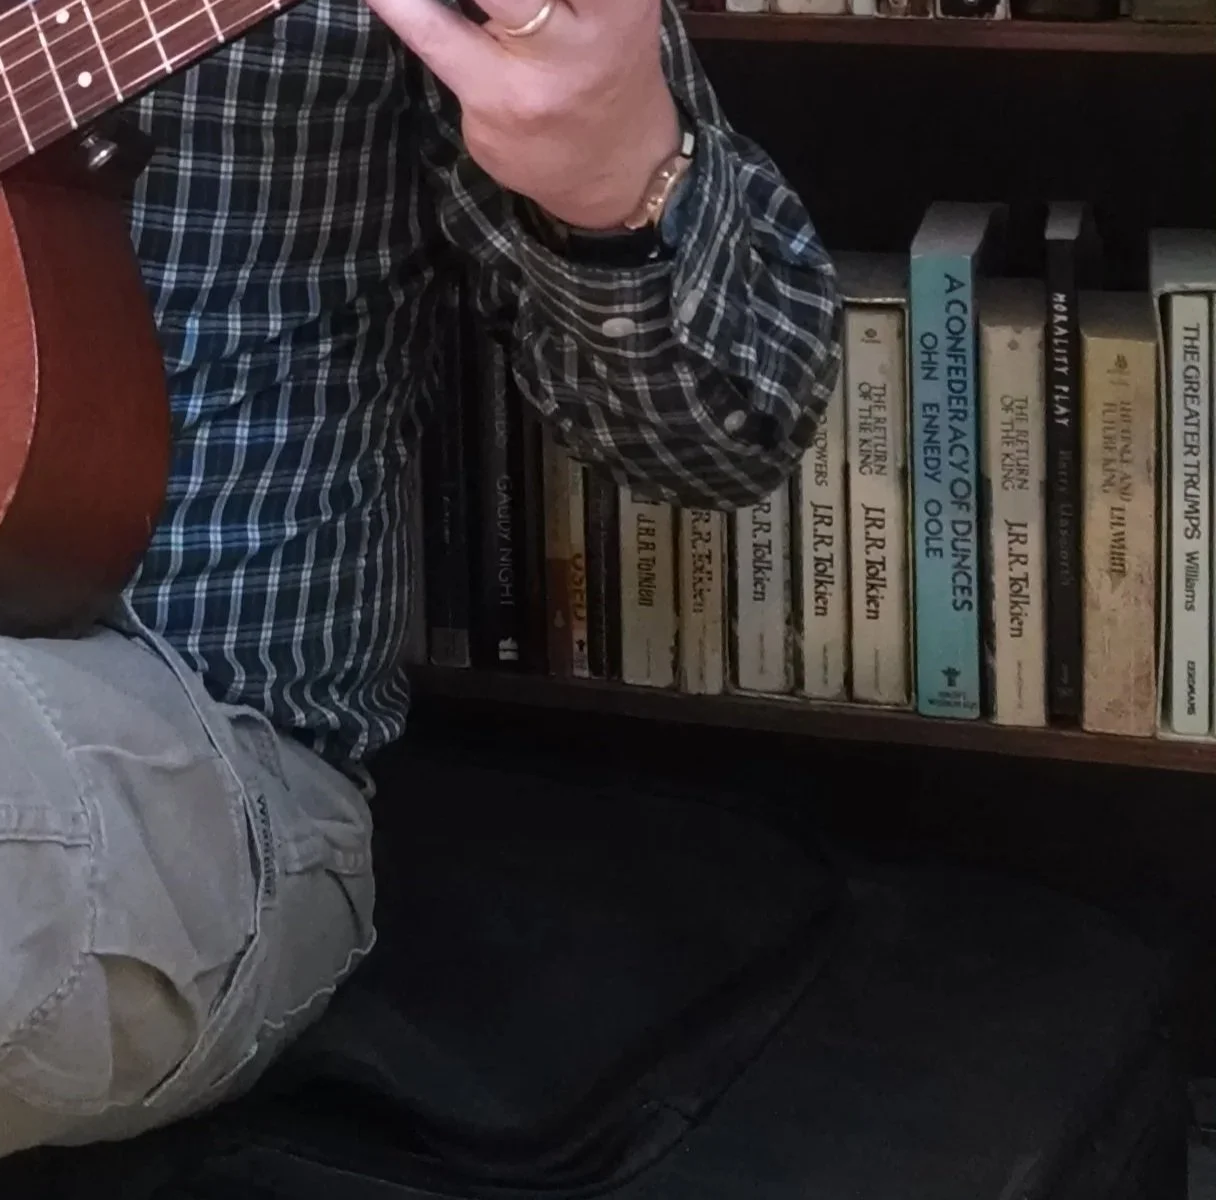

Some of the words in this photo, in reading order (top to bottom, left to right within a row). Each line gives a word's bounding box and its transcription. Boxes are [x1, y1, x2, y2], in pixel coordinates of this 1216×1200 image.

[943, 272, 965, 295] A
[919, 331, 939, 381] OHN
[1051, 292, 1071, 377] MORALITY
[1183, 322, 1202, 362] THE
[858, 382, 873, 402] OF
[872, 384, 887, 413] THE
[945, 297, 973, 476] CONFEDERACY
[999, 394, 1014, 415] OF
[1013, 395, 1029, 423] THE
[1053, 384, 1072, 428] PLAY
[1183, 364, 1202, 457] GREATER
[858, 406, 873, 435] THE
[873, 416, 888, 477] RETURN
[921, 402, 942, 484] ENNEDY
[1000, 421, 1015, 448] THE
[814, 431, 829, 488] TOWERS
[858, 439, 874, 477] KING
[1000, 453, 1016, 491] KING
[1014, 429, 1030, 491] RETURN
[496, 474, 513, 542] GAUDY
[950, 478, 973, 511] OF
[1184, 460, 1202, 541] TRUMPS
[810, 501, 834, 552] J.R.R.
[861, 502, 887, 555] J.R.R.
[923, 499, 943, 559] OOLE
[1004, 519, 1029, 572] J.R.R.
[692, 550, 714, 614] Tolkien
[752, 540, 773, 602] Tolkien
[813, 553, 835, 617] Tolkien
[865, 557, 888, 621] Tolkien
[951, 518, 974, 612] DUNCES
[1184, 550, 1200, 613] Williams
[1006, 573, 1031, 639] Tolkien
